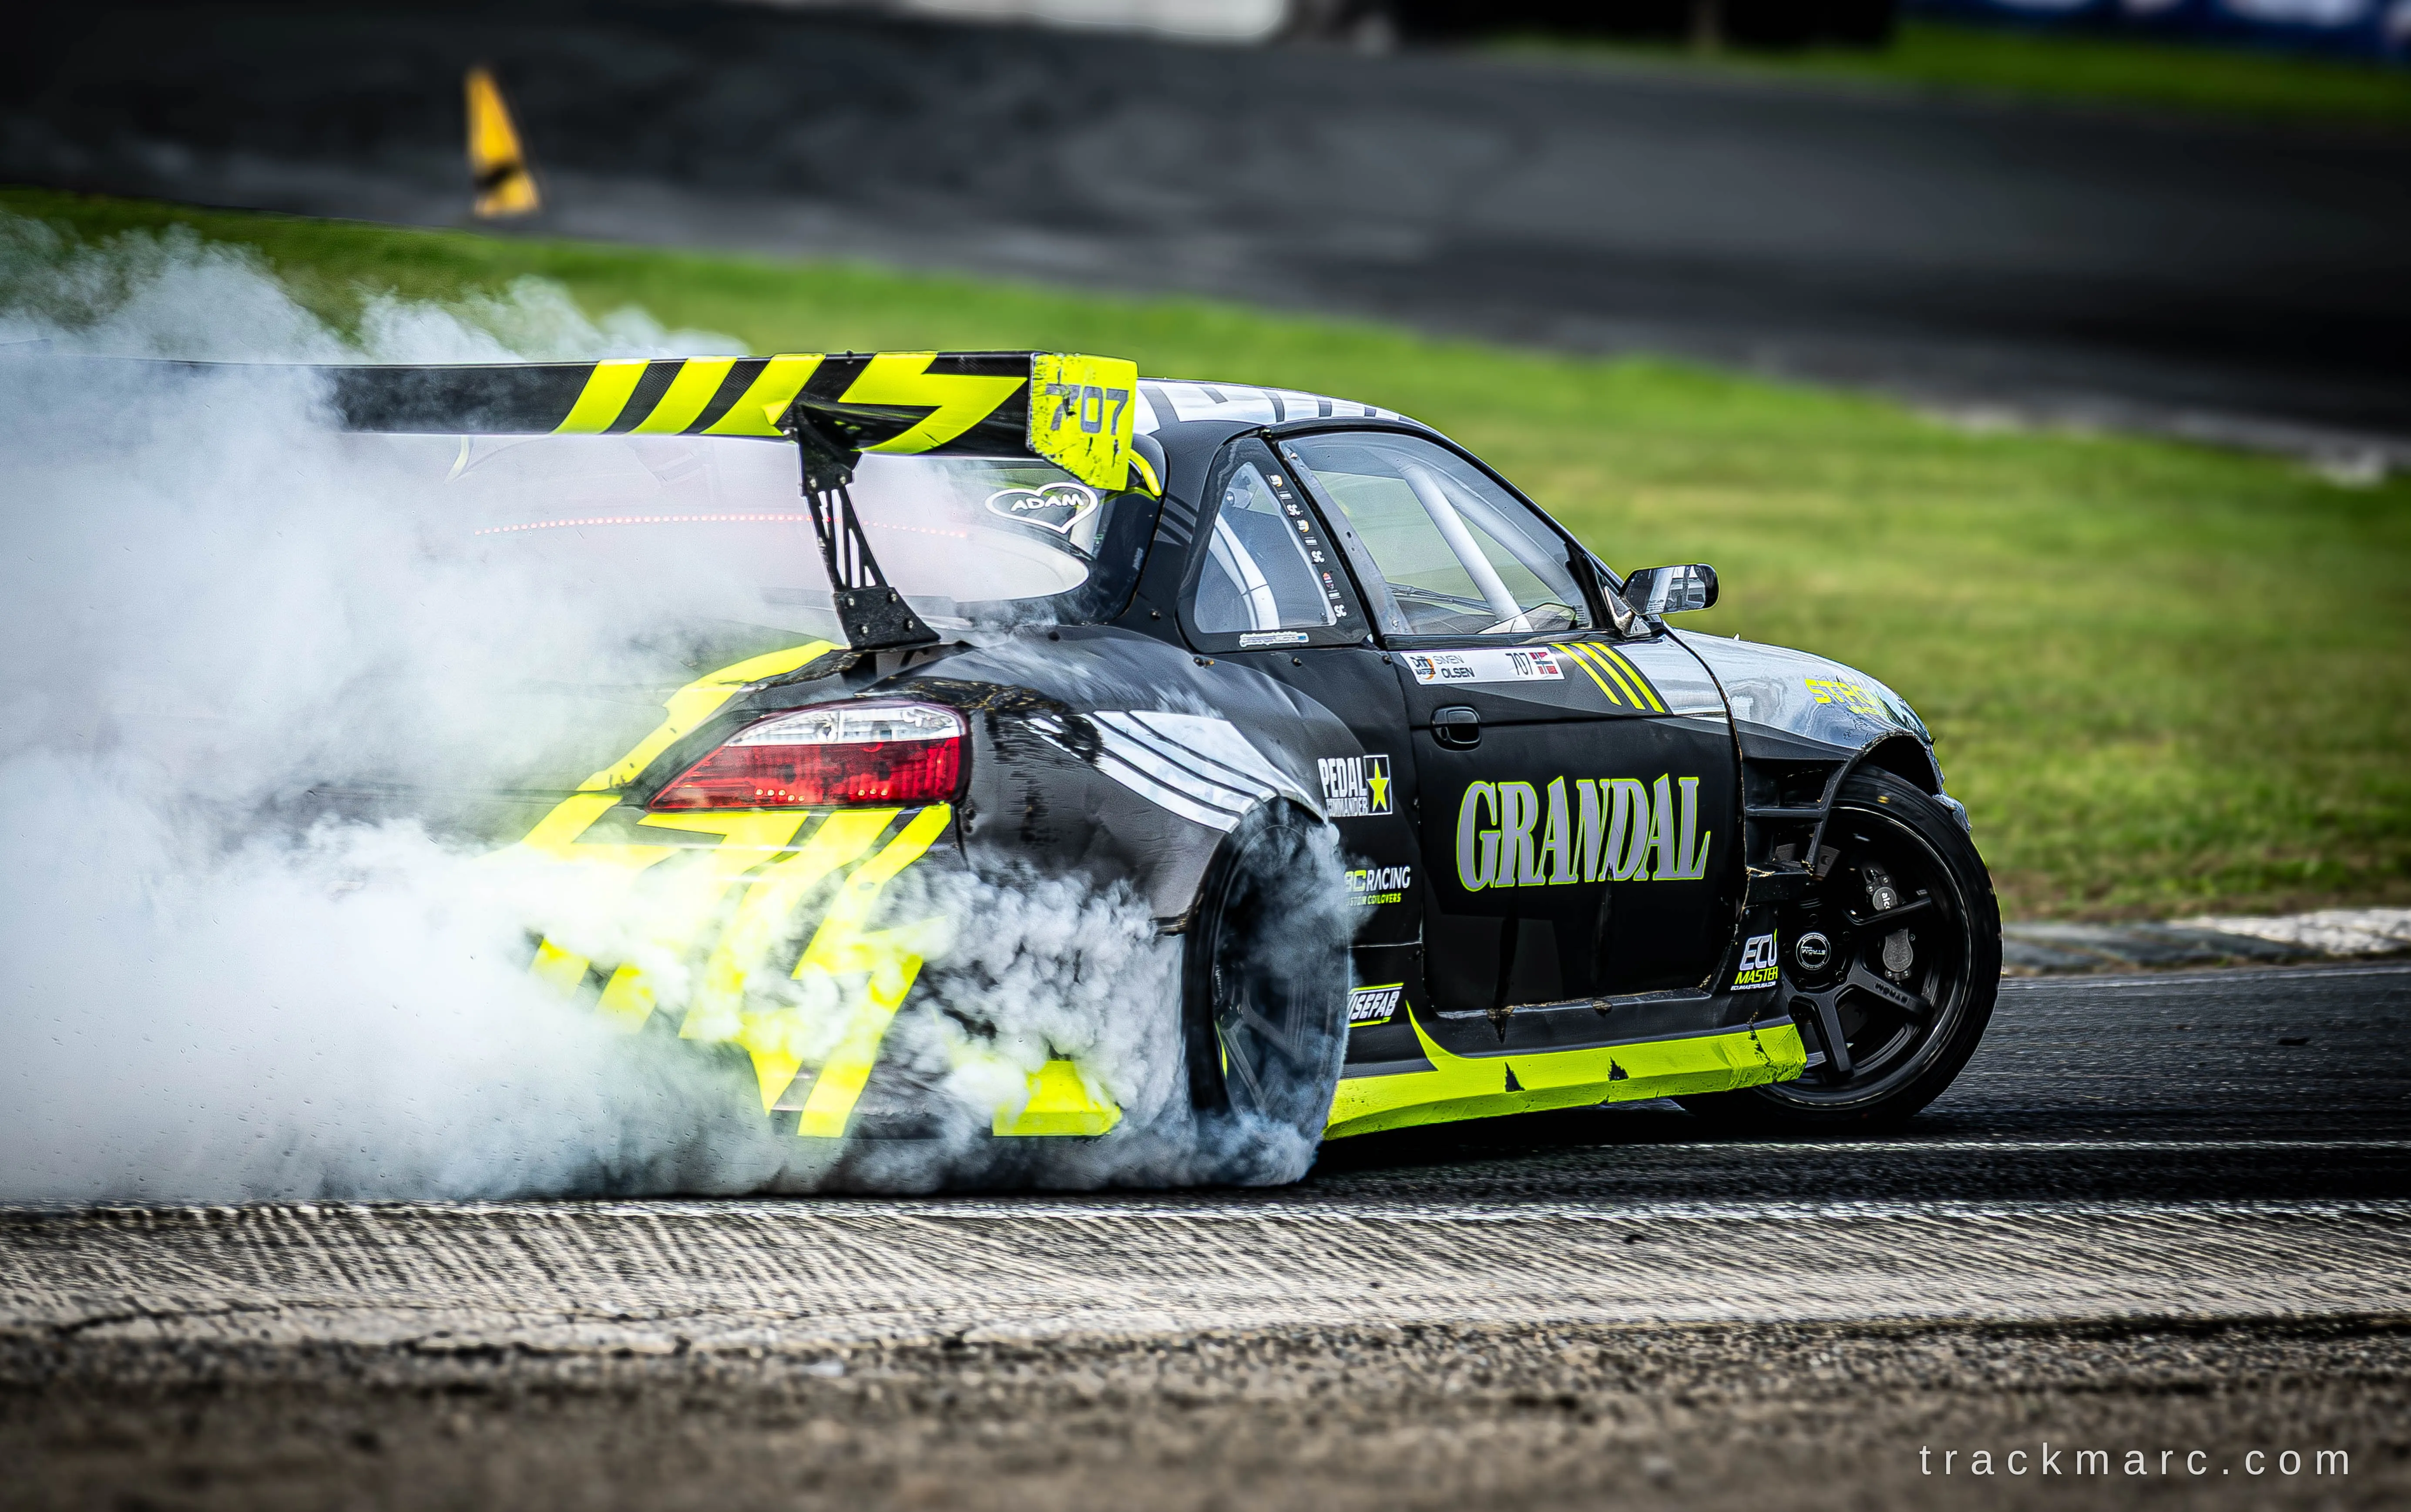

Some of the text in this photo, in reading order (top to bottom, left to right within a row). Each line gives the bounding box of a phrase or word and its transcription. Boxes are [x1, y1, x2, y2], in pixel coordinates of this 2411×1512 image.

[1045, 383, 1129, 435] 707
[1011, 494, 1084, 512] ADAM
[1441, 667, 1475, 678] OLSEN
[1505, 652, 1533, 675] 707
[1317, 757, 1367, 798] PEDAL
[1456, 773, 1711, 892] GRANDAL
[1739, 928, 1777, 971] ECU
[1734, 966, 1778, 984] MASTER
[1349, 991, 1400, 1020] ISEFAB
